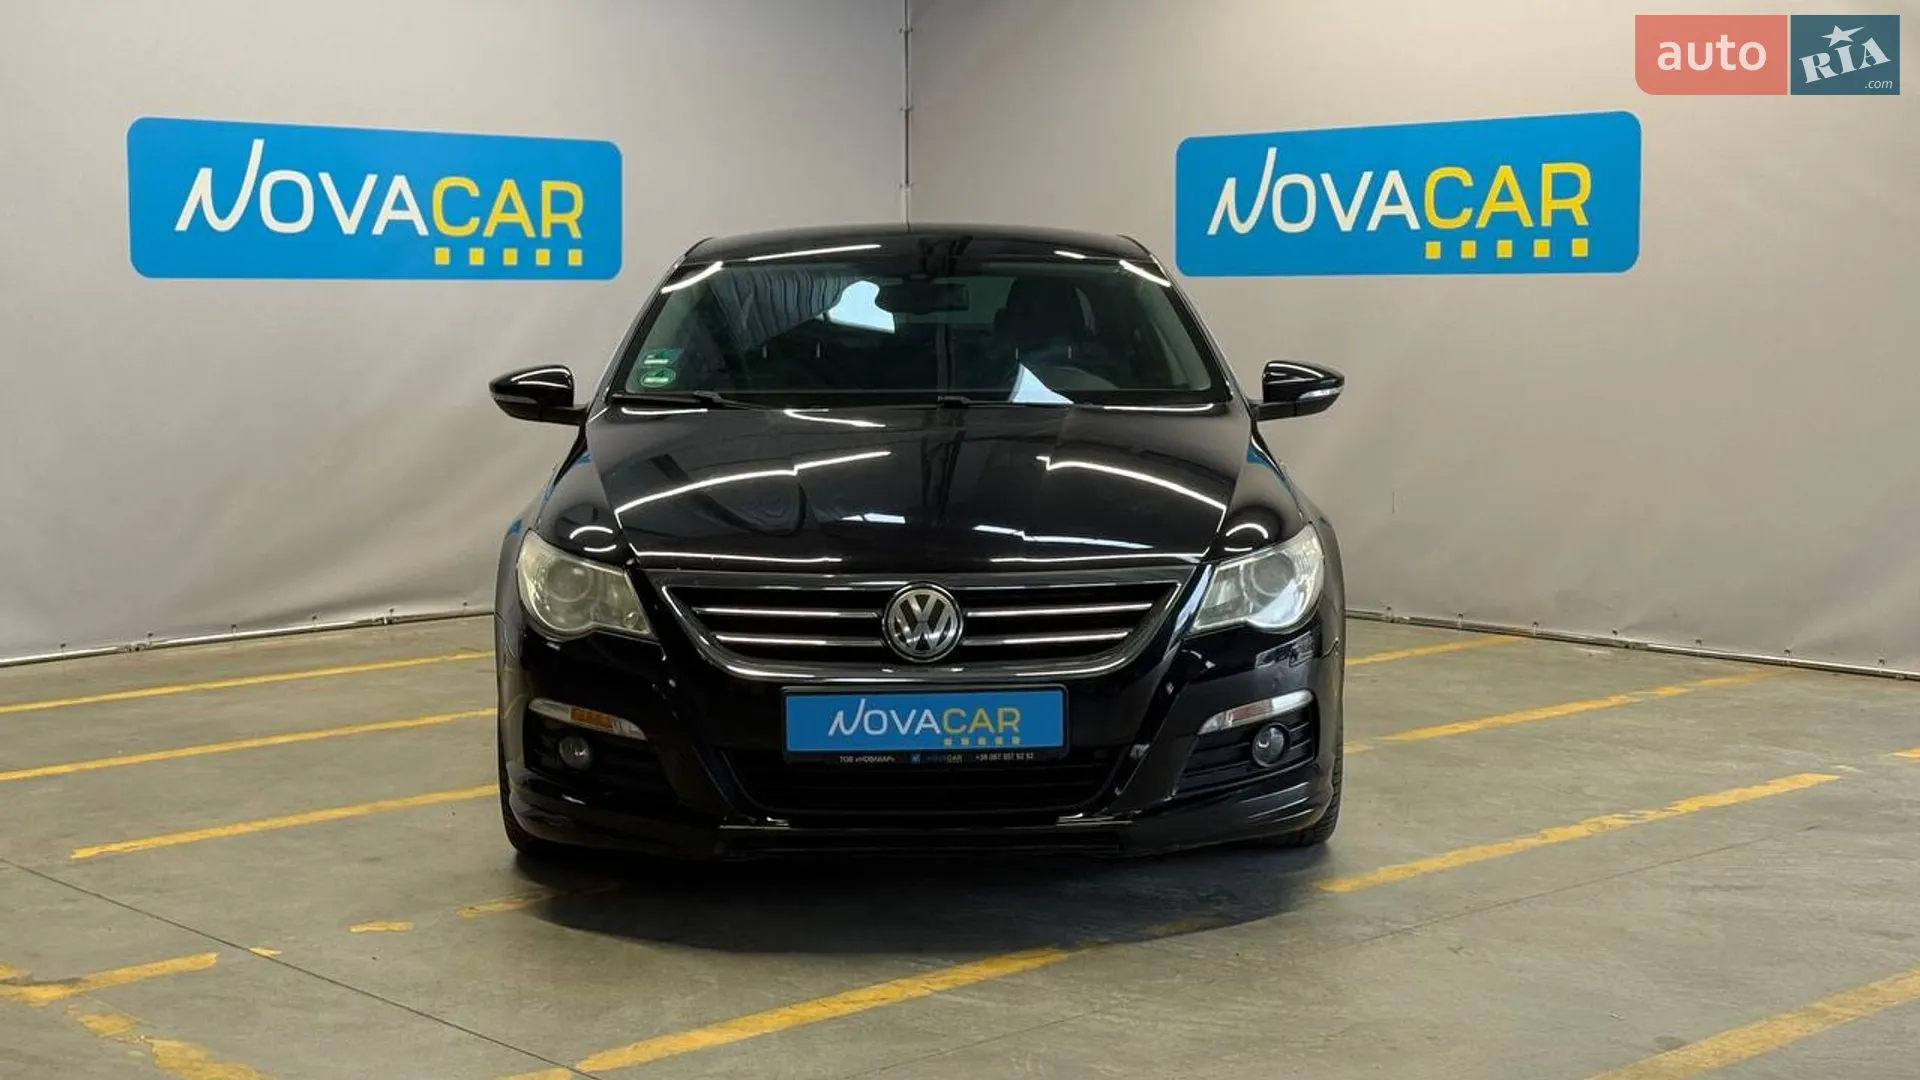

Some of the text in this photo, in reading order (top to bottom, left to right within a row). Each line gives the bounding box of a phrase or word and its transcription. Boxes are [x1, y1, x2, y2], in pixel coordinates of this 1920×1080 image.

[174, 138, 585, 240] NOVACAR
[1206, 146, 1593, 236] NOVACAR
[828, 698, 1021, 737] NOVACAR
